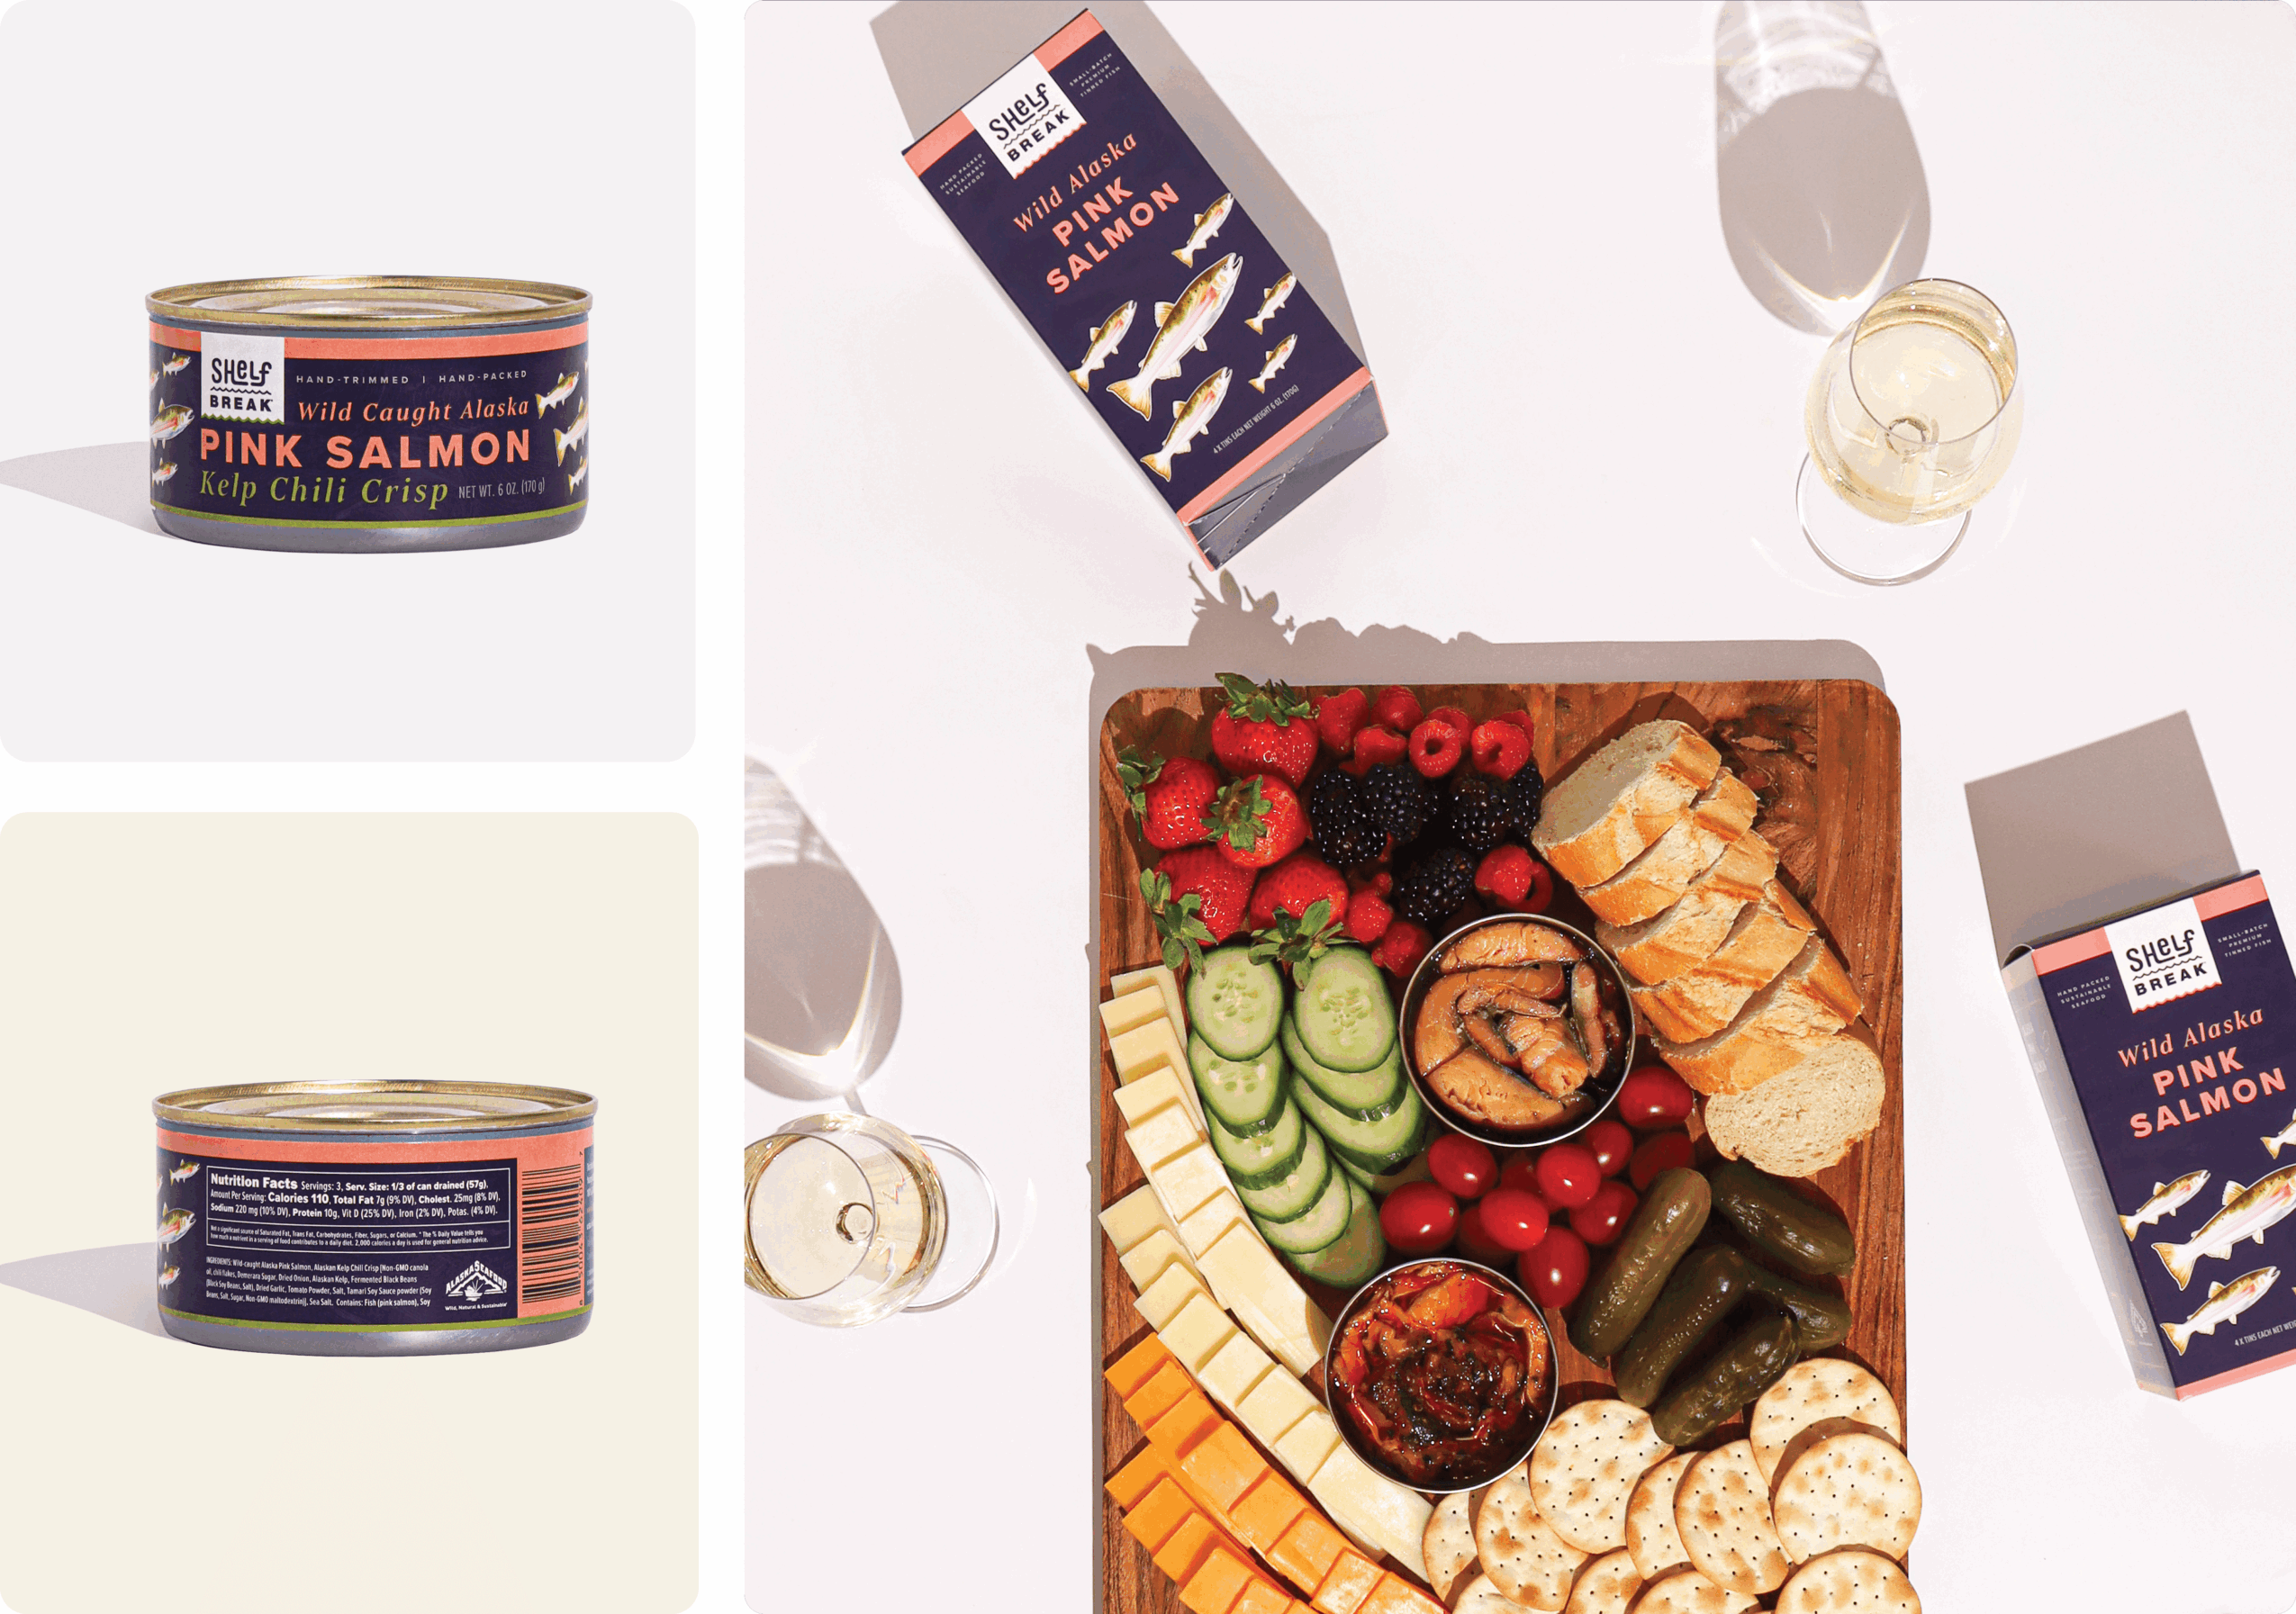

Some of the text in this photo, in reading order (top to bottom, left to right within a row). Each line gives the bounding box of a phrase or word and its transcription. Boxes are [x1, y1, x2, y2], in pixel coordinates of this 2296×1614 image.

[1080, 64, 1110, 87] PREMIUM
[1080, 66, 1120, 97] TINNED FISH
[1007, 109, 1070, 162] BREAK
[958, 153, 982, 175] PACKED
[945, 160, 986, 195] SUSTAINABLE
[956, 171, 985, 196] SEAFOOD
[1013, 133, 1137, 232] Wild Alaska
[1052, 176, 1134, 248] PINK
[1046, 182, 1180, 294] SALMON
[296, 369, 528, 384] HAND-TRIMMED HAND-PACKED
[210, 395, 271, 411] BREAK
[298, 396, 529, 428] Wild Caught Alaska
[1216, 444, 1223, 452] X
[1220, 436, 1234, 448] TINS
[1230, 426, 1245, 440] EACH
[1243, 419, 1254, 430] NET
[1252, 405, 1272, 423] WEIGHT
[1270, 401, 1277, 410] 6
[1274, 397, 1285, 407] OZ.
[1281, 383, 1300, 401] (170G)
[201, 428, 530, 469] PINK SALMON
[200, 470, 545, 510] Kelp Chili Crisp NET WT. 6 OZ. (170 g)
[2217, 923, 2268, 943] SMALL-BATCH
[2228, 933, 2262, 948] PREMIUM
[2224, 939, 2272, 958] TINNED FISH
[2056, 976, 2110, 997] HAND PACKED
[2134, 962, 2208, 996] BREAK
[2060, 983, 2111, 1005] SUSTAINABLE
[2071, 994, 2106, 1009] SEAFOOD
[2117, 1008, 2264, 1068] Wild Alaska
[2152, 1046, 2245, 1096] PINK
[2129, 1067, 2286, 1139] SALMON
[211, 1173, 259, 1188] Nutrition
[263, 1177, 298, 1189] Facts
[302, 1181, 334, 1192] Servings:
[336, 1182, 344, 1192] 3,
[346, 1183, 366, 1191] Serv.
[369, 1182, 389, 1191] Size:
[391, 1182, 404, 1191] 1/3
[406, 1182, 415, 1191] of
[434, 1180, 465, 1189] drained
[211, 1189, 501, 1206] Amount Per Serving: Calories 110, Total Fat 7g (9% DV), Cholest. 25mg (8% DV),
[211, 1203, 233, 1213] Sodium
[235, 1204, 247, 1213] 220
[249, 1207, 258, 1216] mg
[259, 1206, 276, 1216] (10%
[293, 1209, 322, 1217] Protein
[324, 1209, 339, 1219] 10g,
[342, 1209, 352, 1217] Vit
[354, 1209, 358, 1218] D
[361, 1209, 380, 1220] (25%
[382, 1209, 396, 1220] DV),
[399, 1209, 413, 1217] Iron
[416, 1208, 429, 1219] (2%
[448, 1207, 468, 1216] Potas.
[471, 1205, 484, 1217] (4%
[238, 1271, 260, 1280] Demerara
[261, 1261, 277, 1269] Alaska
[279, 1262, 290, 1270] Pink
[291, 1263, 312, 1271] Salmon,
[337, 1264, 349, 1272] Kelp
[351, 1264, 363, 1272] Chili
[365, 1265, 379, 1273] Crisp
[446, 1260, 507, 1294] ALASKA SEAFOOD
[246, 1294, 268, 1303] Non-GMO
[377, 1298, 393, 1307] (pink
[420, 1298, 430, 1307] Soy
[256, 1284, 269, 1292] Dried
[309, 1286, 331, 1294] Powder,
[332, 1287, 346, 1295] Salt,
[367, 1287, 377, 1295] Soy
[397, 1286, 419, 1295] powder
[420, 1286, 431, 1295] (Soy
[2234, 1339, 2239, 1347] 4
[2243, 1333, 2257, 1344] TINS
[2256, 1328, 2273, 1339] EACH
[2272, 1324, 2283, 1334] NET
